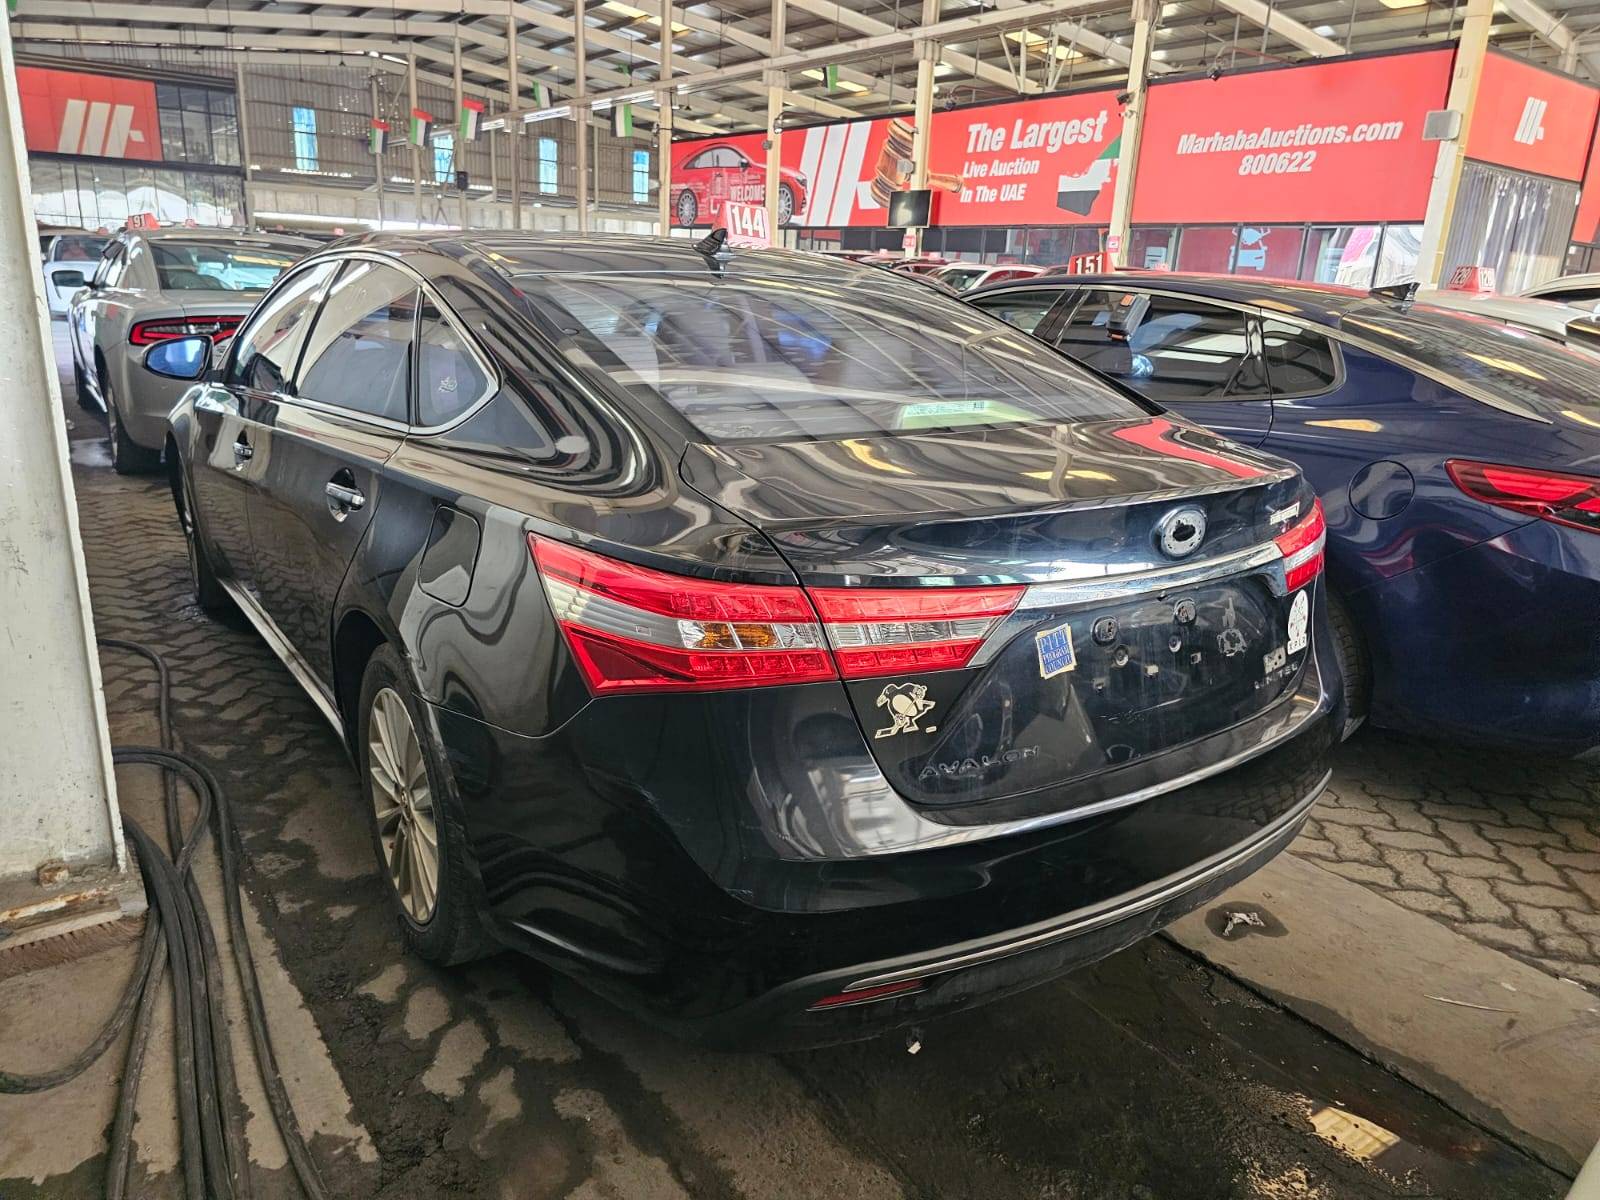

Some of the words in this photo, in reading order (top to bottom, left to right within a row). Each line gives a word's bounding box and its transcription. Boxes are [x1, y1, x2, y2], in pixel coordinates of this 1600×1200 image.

[967, 122, 1006, 153] The
[1010, 110, 1108, 153] Largest
[1176, 120, 1404, 155] MarhabaAuctions.com
[963, 161, 988, 178] Live
[989, 157, 1041, 177] Auction
[1238, 150, 1317, 176] 800622
[729, 184, 766, 202] WELCOME
[960, 186, 973, 203] In
[974, 185, 999, 203] The
[1000, 183, 1028, 201] UAE
[731, 204, 766, 240] 144
[1075, 253, 1103, 275] 151
[1039, 629, 1067, 654] PITT
[918, 745, 1040, 781] AVALON
